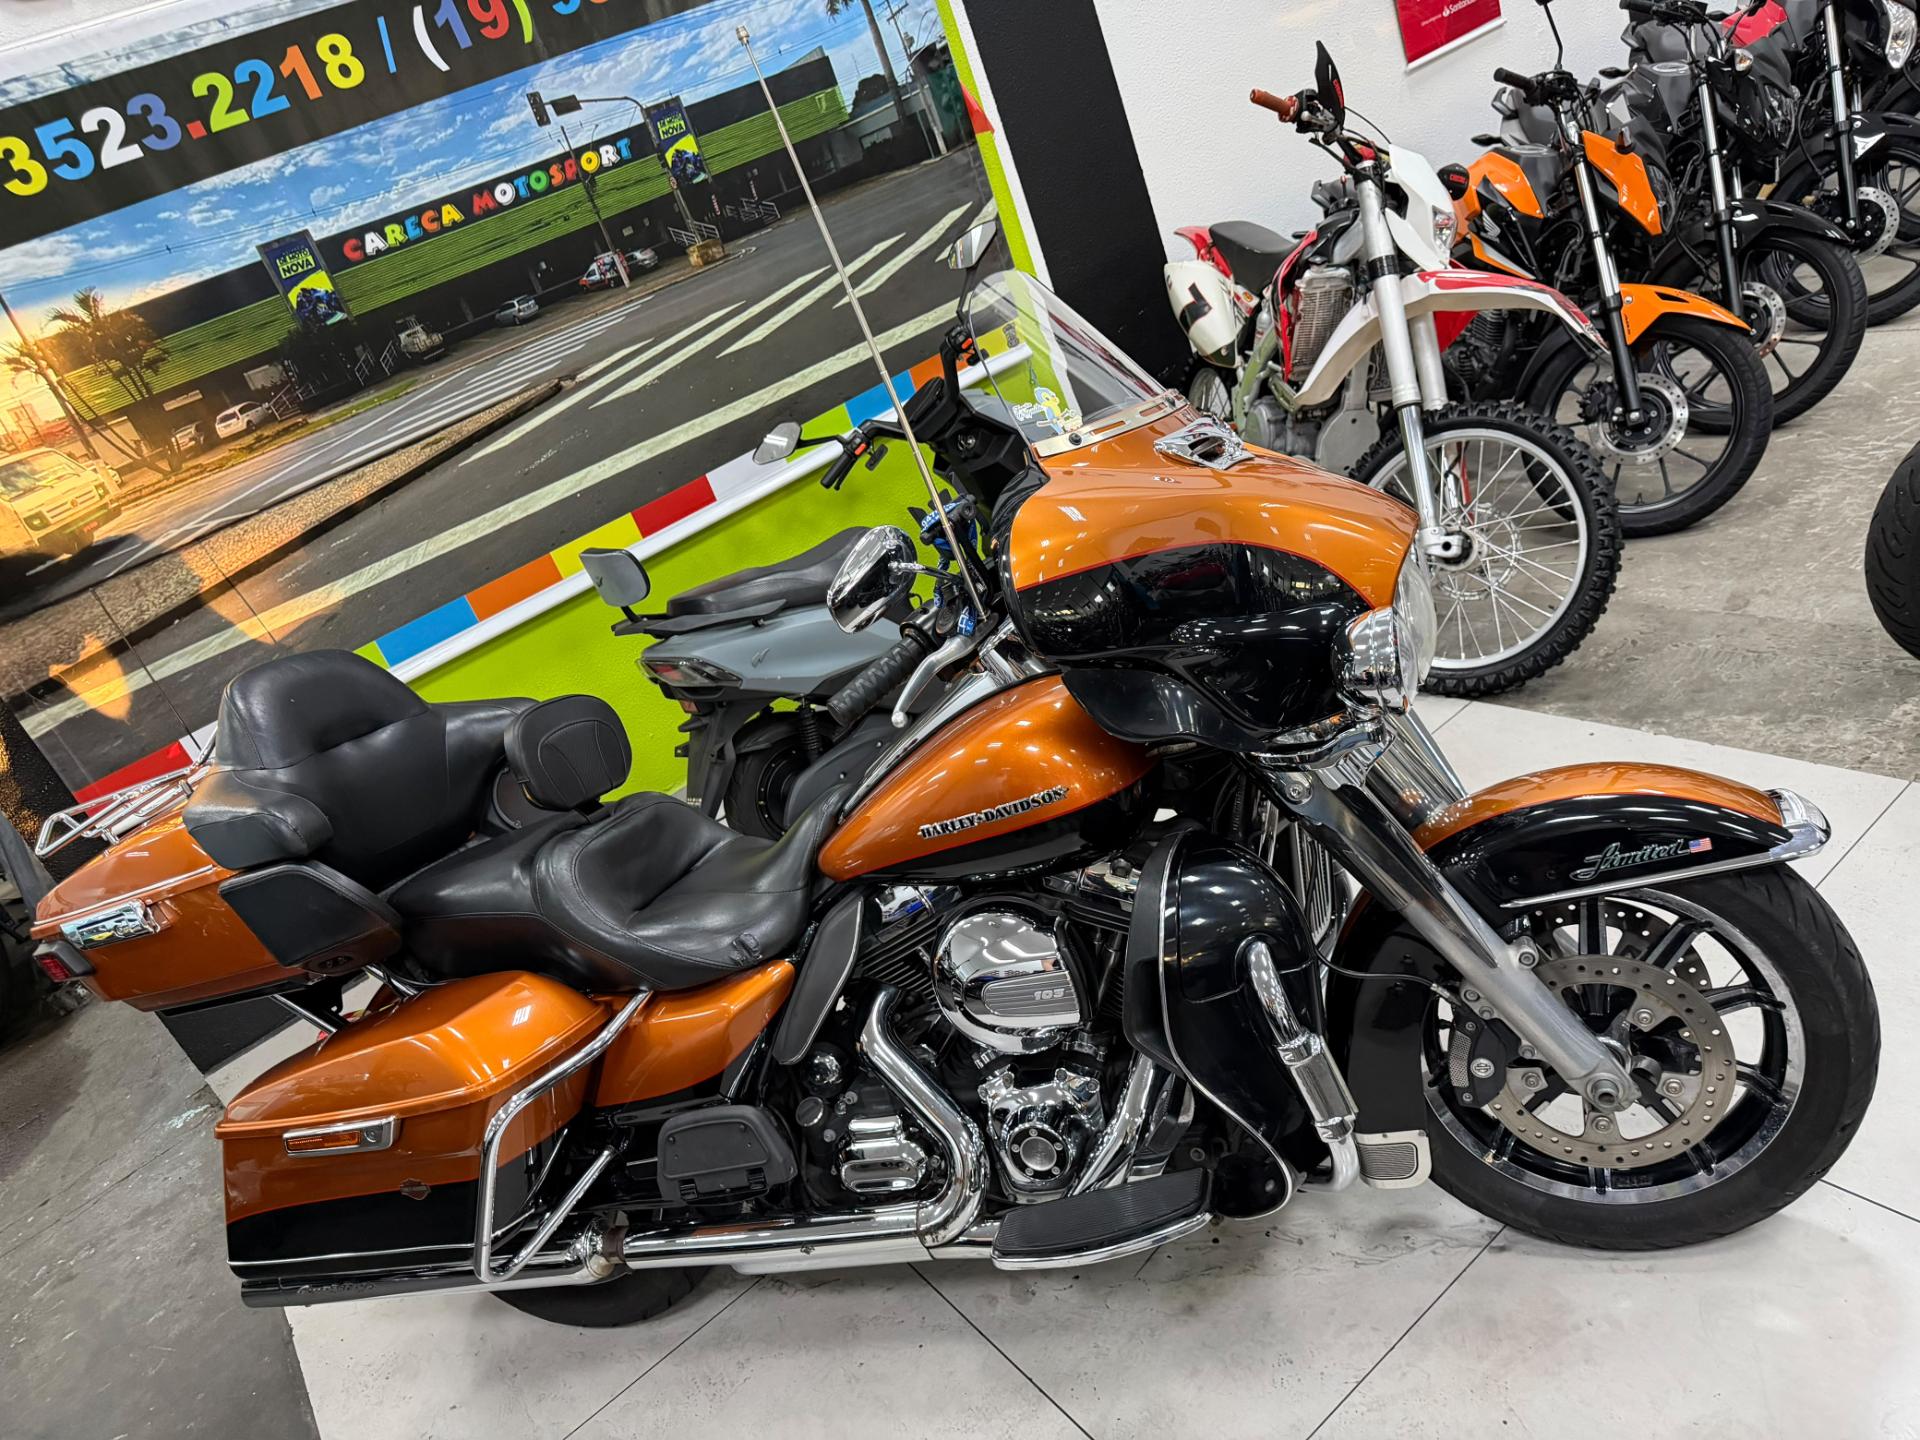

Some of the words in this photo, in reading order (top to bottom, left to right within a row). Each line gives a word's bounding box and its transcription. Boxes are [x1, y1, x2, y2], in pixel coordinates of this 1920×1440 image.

[0, 33, 365, 197] 3523.2218
[413, 0, 533, 73] (19)
[343, 203, 465, 262] CARECA
[472, 137, 633, 216] MOTOSPORT
[281, 257, 313, 277] NOVA
[918, 785, 1069, 839] HARLEY-DAVIDSON
[1569, 838, 1691, 881] Limited
